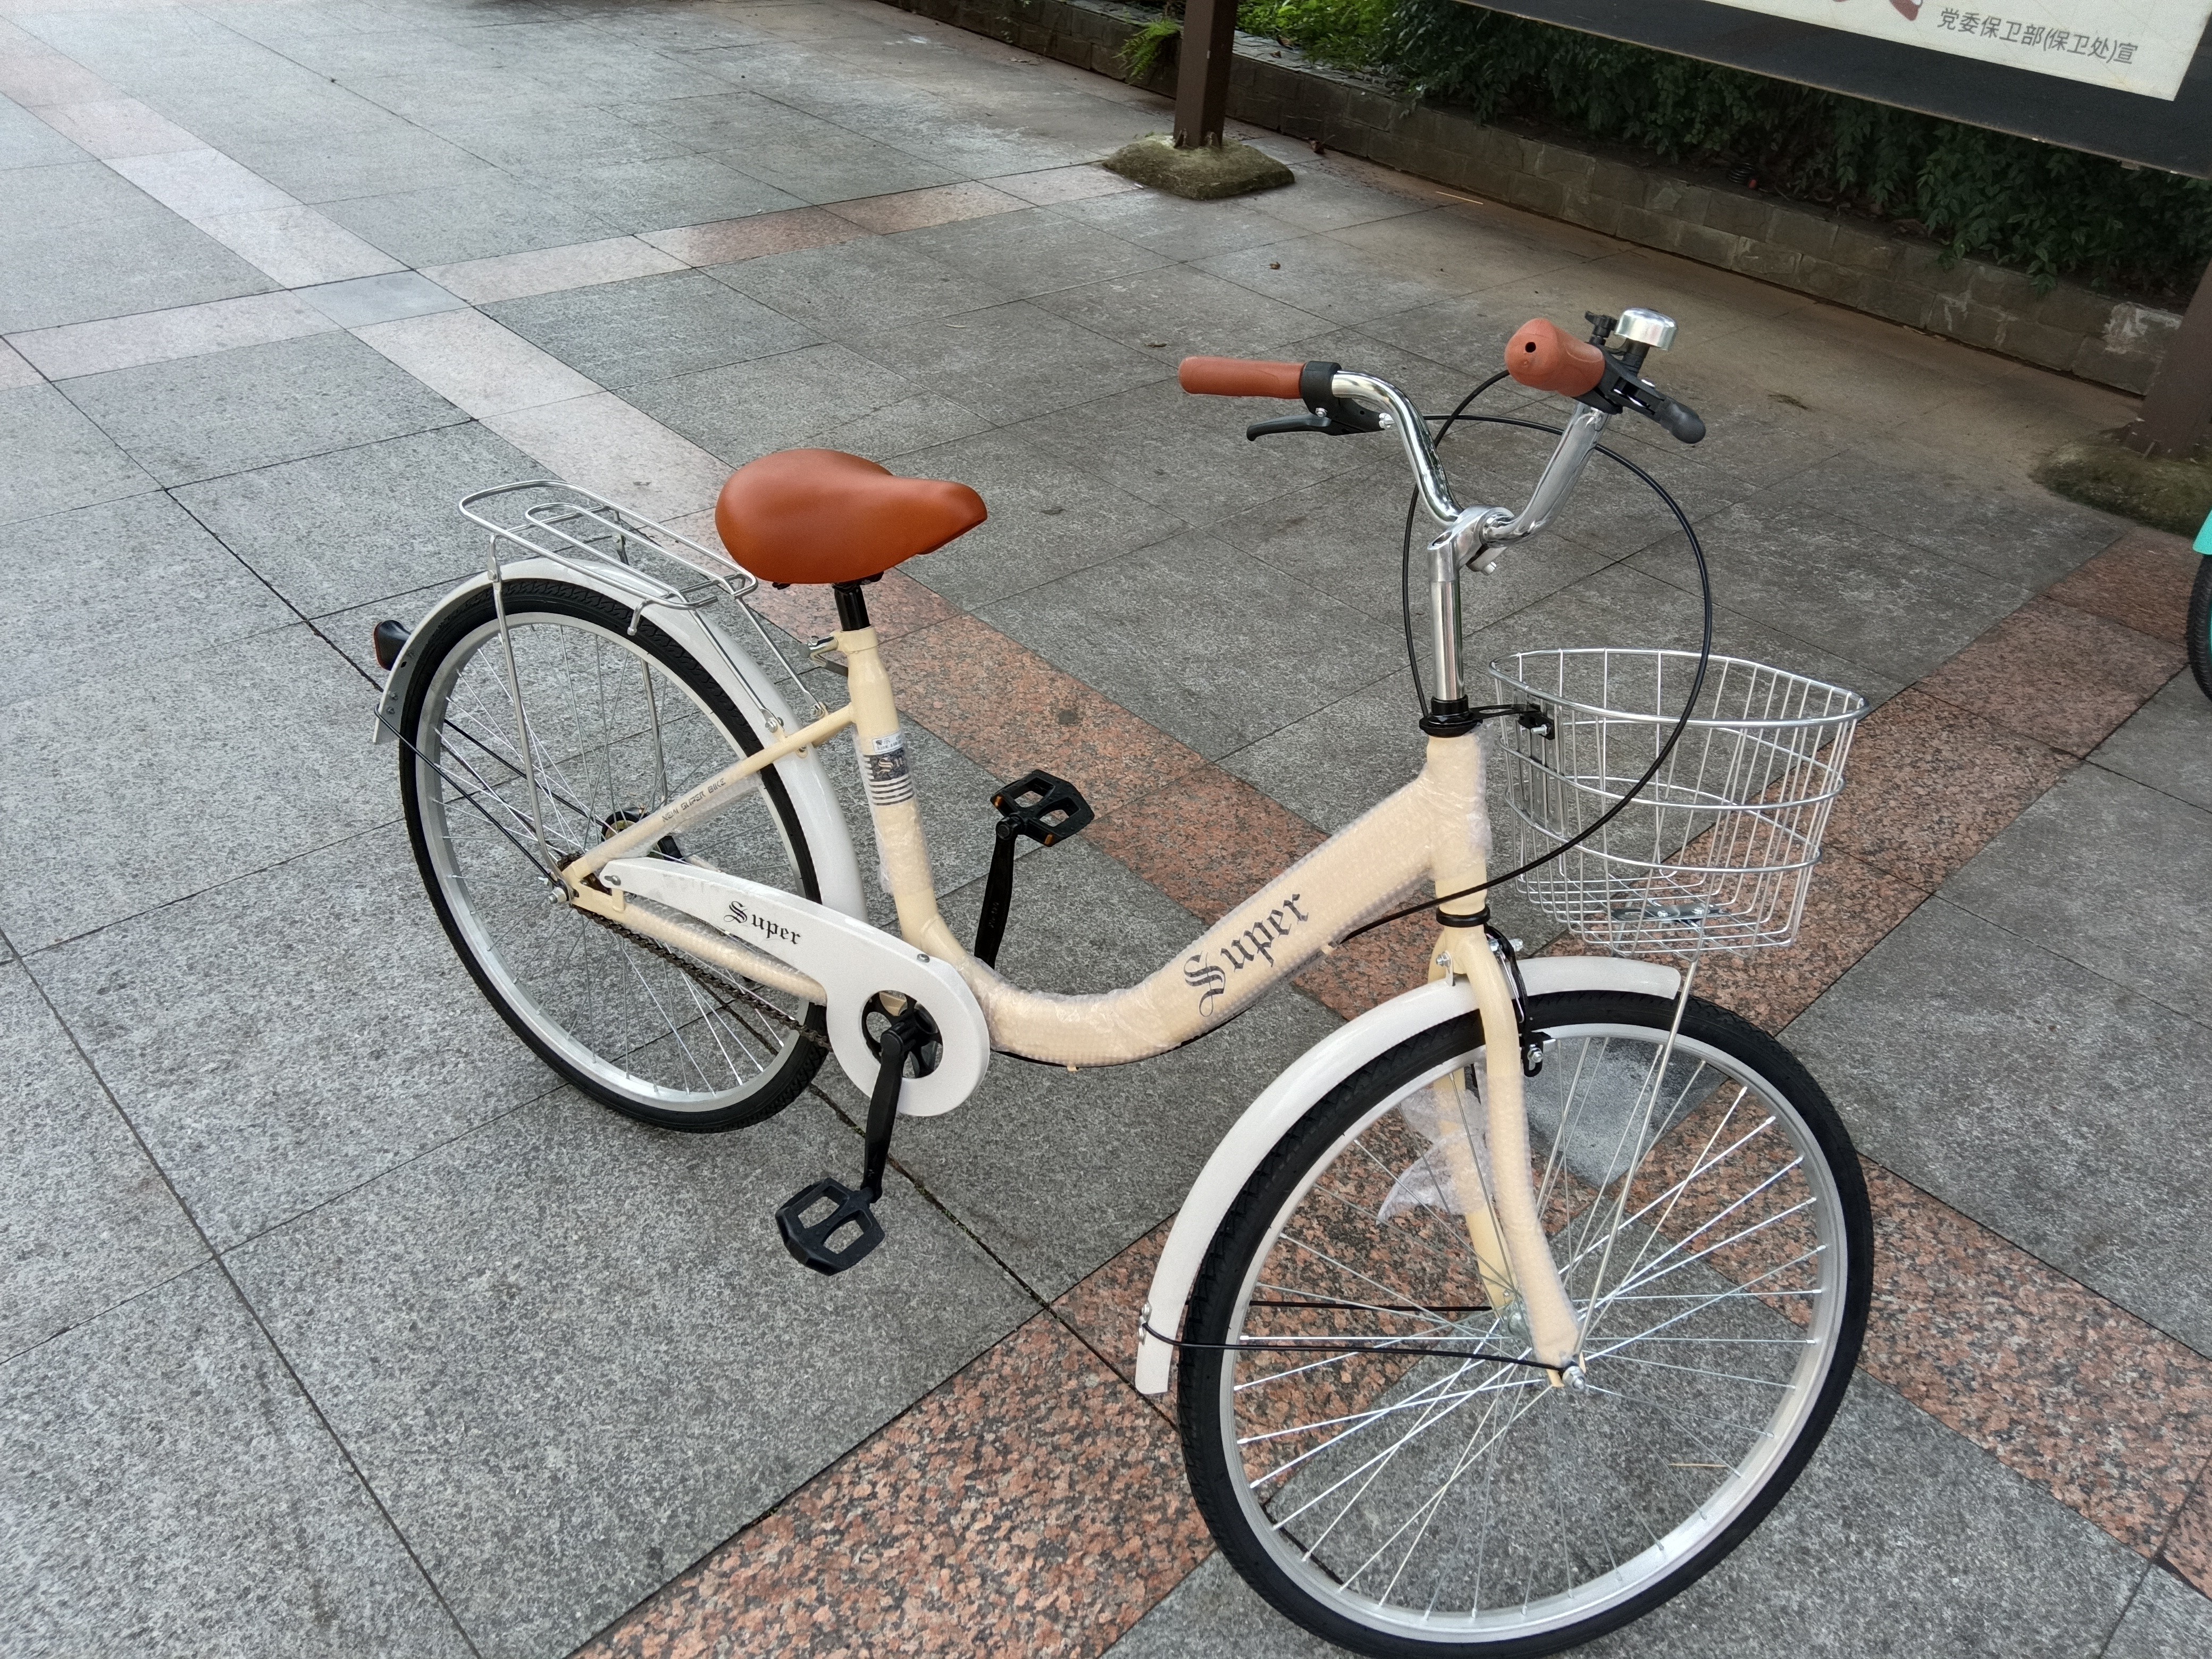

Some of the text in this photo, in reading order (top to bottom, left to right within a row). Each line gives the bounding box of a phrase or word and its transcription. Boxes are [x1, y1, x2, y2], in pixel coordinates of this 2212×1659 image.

[1937, 7, 2138, 64] 党委保卫部(保卫处)宣
[681, 791, 706, 810] SUPER
[707, 778, 726, 793] BIKE
[723, 901, 801, 944] Super
[1183, 893, 1309, 1017] Super
